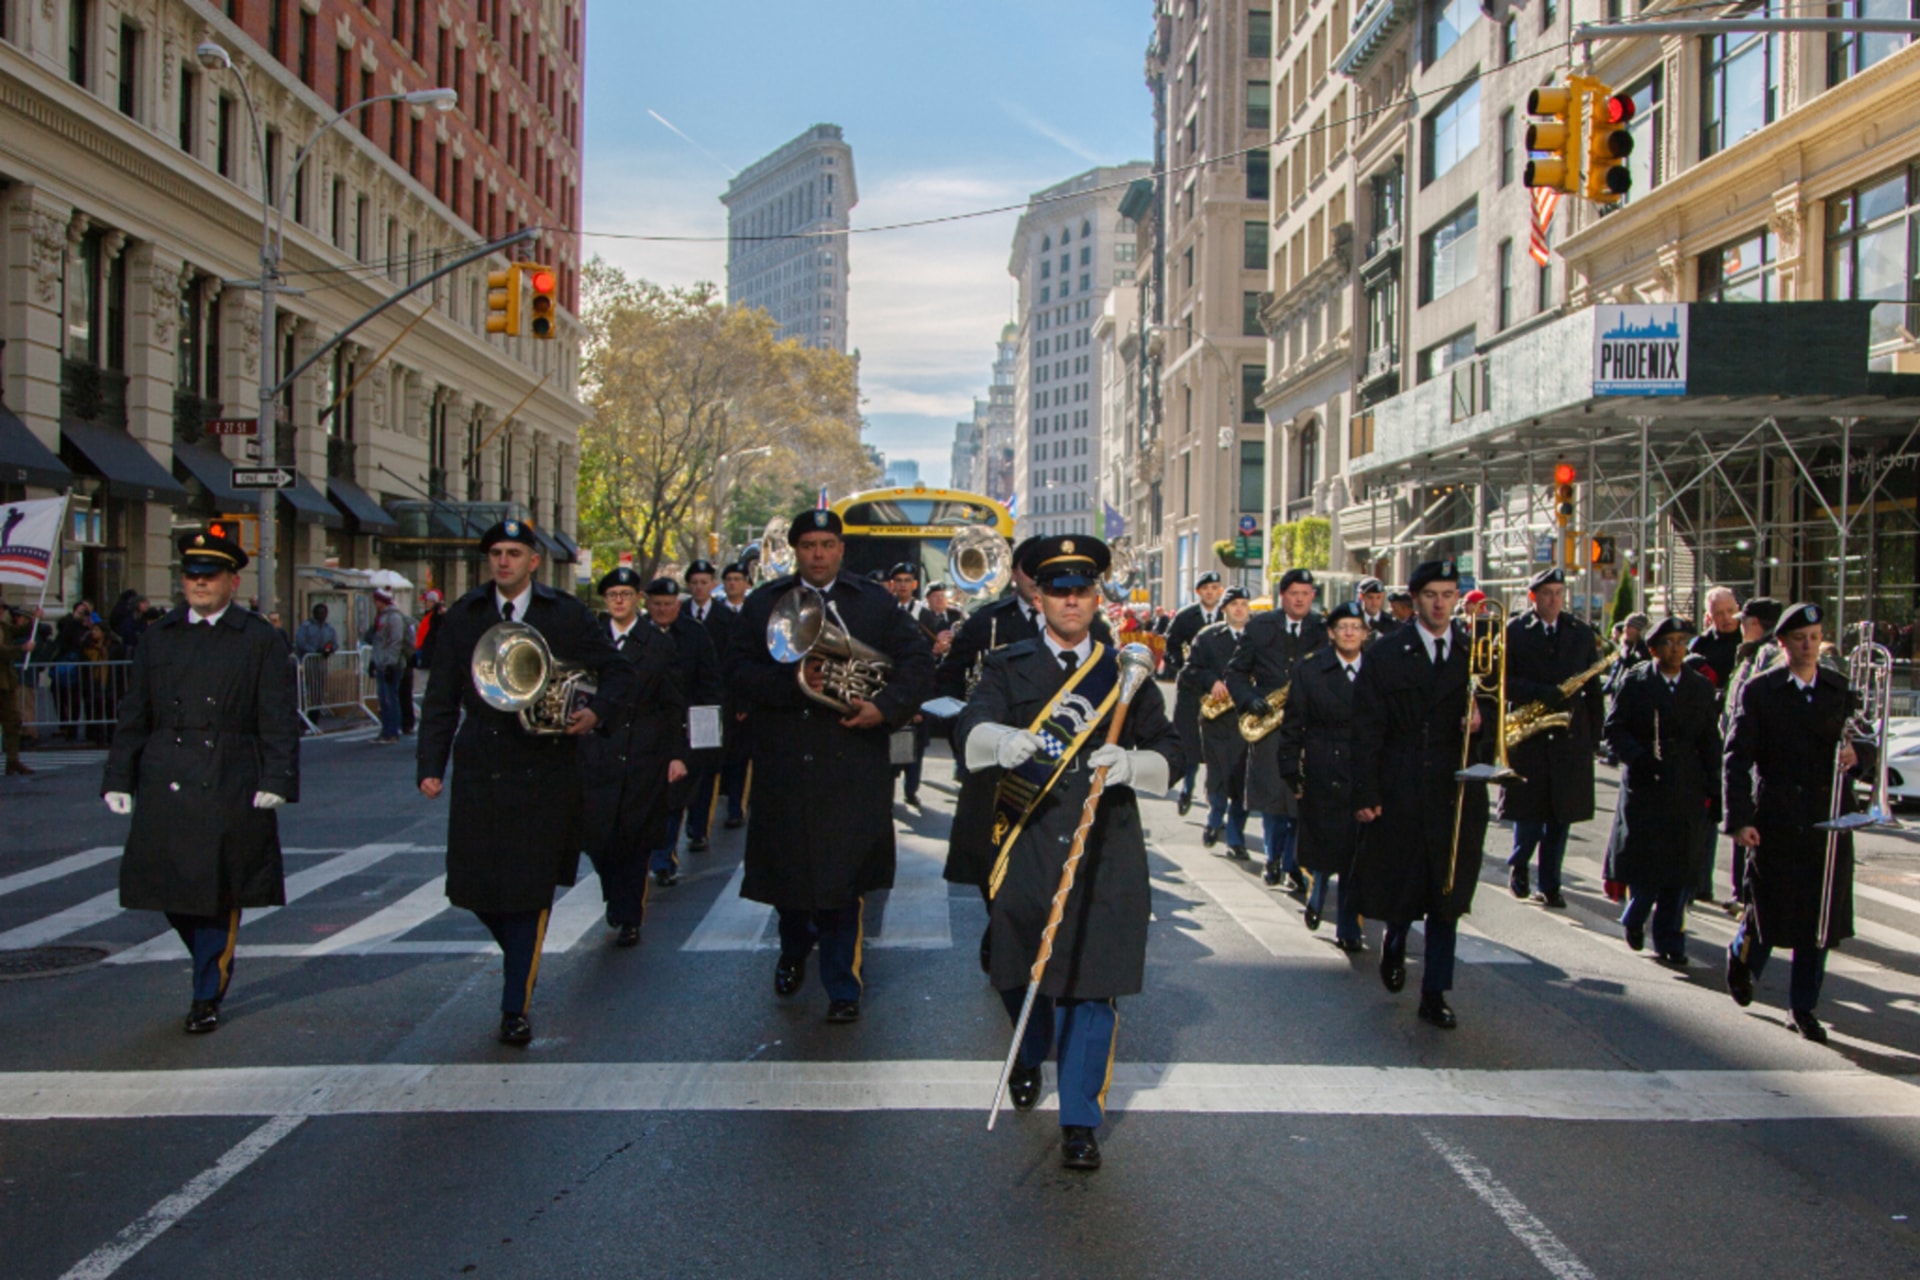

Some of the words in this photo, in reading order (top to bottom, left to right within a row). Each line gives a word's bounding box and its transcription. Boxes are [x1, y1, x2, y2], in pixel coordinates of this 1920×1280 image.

[1601, 342, 1679, 379] PHOENIX
[216, 422, 221, 433] E
[241, 474, 256, 482] ONE
[268, 474, 286, 482] WAY
